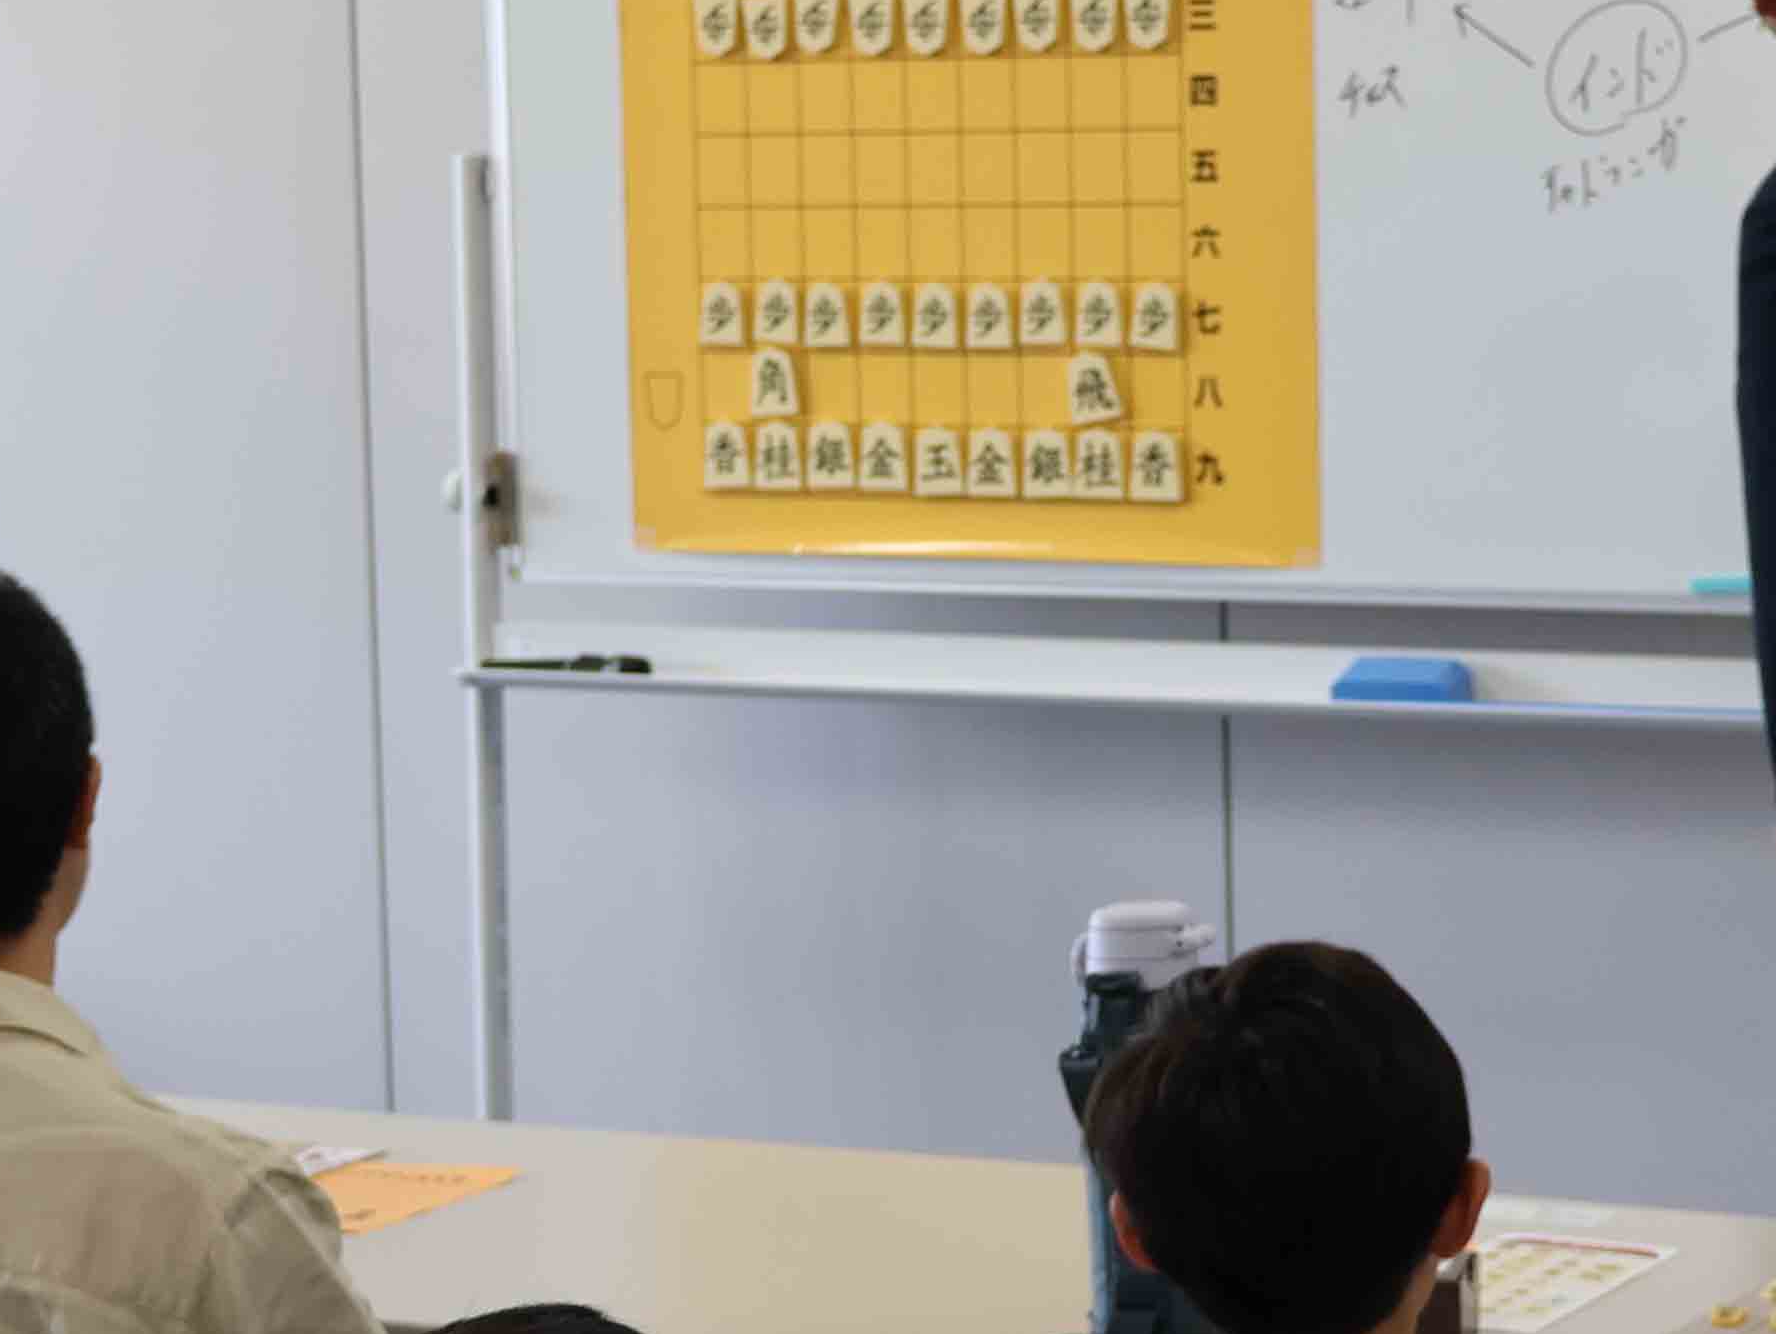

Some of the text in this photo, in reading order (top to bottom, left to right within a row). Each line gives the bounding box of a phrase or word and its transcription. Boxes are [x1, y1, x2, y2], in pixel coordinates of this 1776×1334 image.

[1568, 27, 1675, 112] インド
[1190, 74, 1217, 106] 四
[1191, 150, 1219, 183] 五
[1191, 224, 1220, 257] 六
[1192, 301, 1221, 335] 七
[1193, 377, 1223, 407] 八
[1194, 453, 1225, 485] 九
